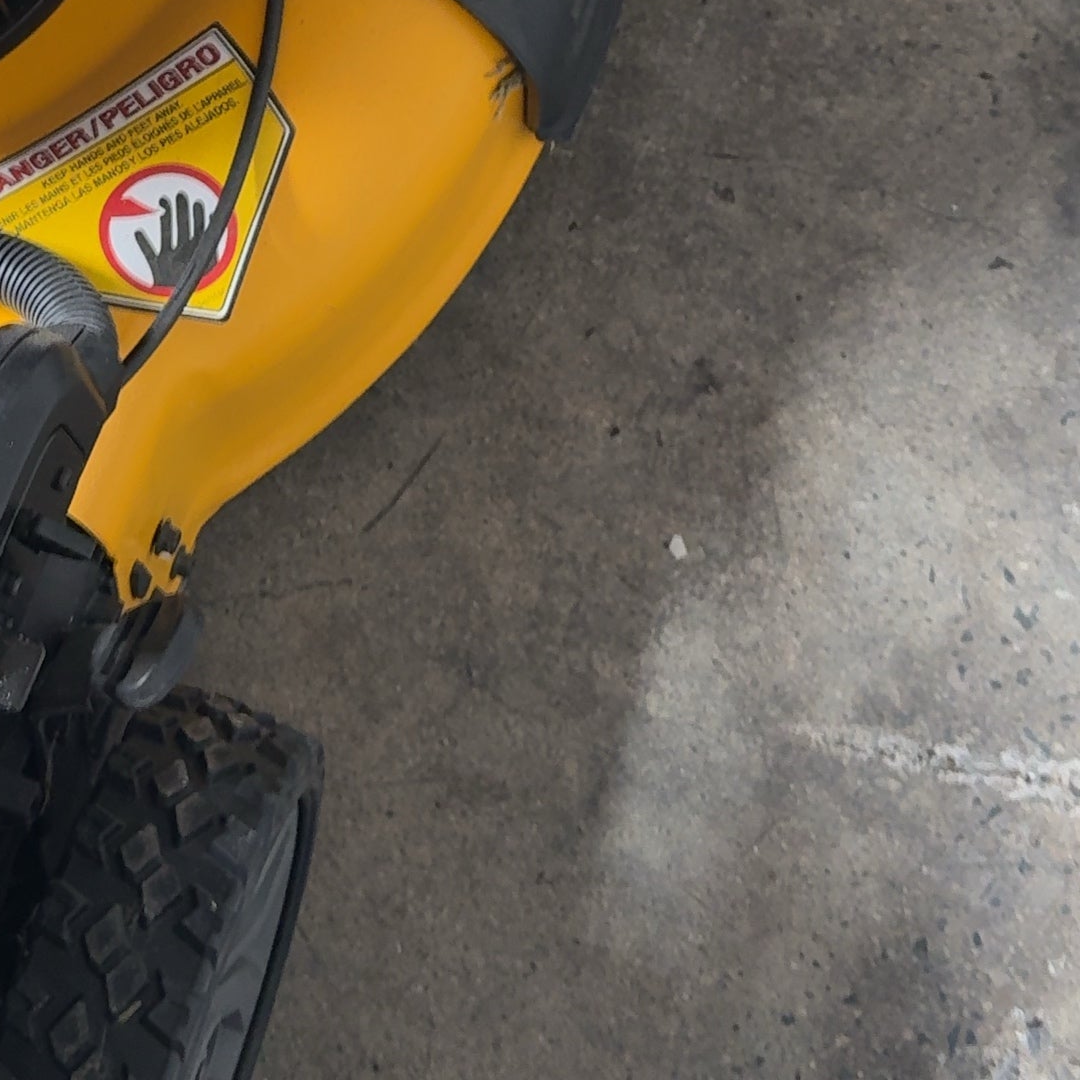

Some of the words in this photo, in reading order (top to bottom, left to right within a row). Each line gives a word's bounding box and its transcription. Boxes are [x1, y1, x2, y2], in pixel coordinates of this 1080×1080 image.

[39, 181, 70, 205] MAINS
[70, 172, 87, 187] ET
[85, 161, 105, 177] LES
[104, 145, 132, 166] PIEDS
[178, 108, 193, 121] DE
[41, 167, 69, 189] KEEP
[70, 149, 106, 173] HANDS
[106, 134, 127, 154] AND
[128, 117, 154, 137] FEET
[73, 183, 93, 203] LAS
[94, 160, 130, 188] MANOS
[129, 154, 138, 167] Y
[137, 144, 160, 161] LOS
[159, 129, 185, 148] PIES
